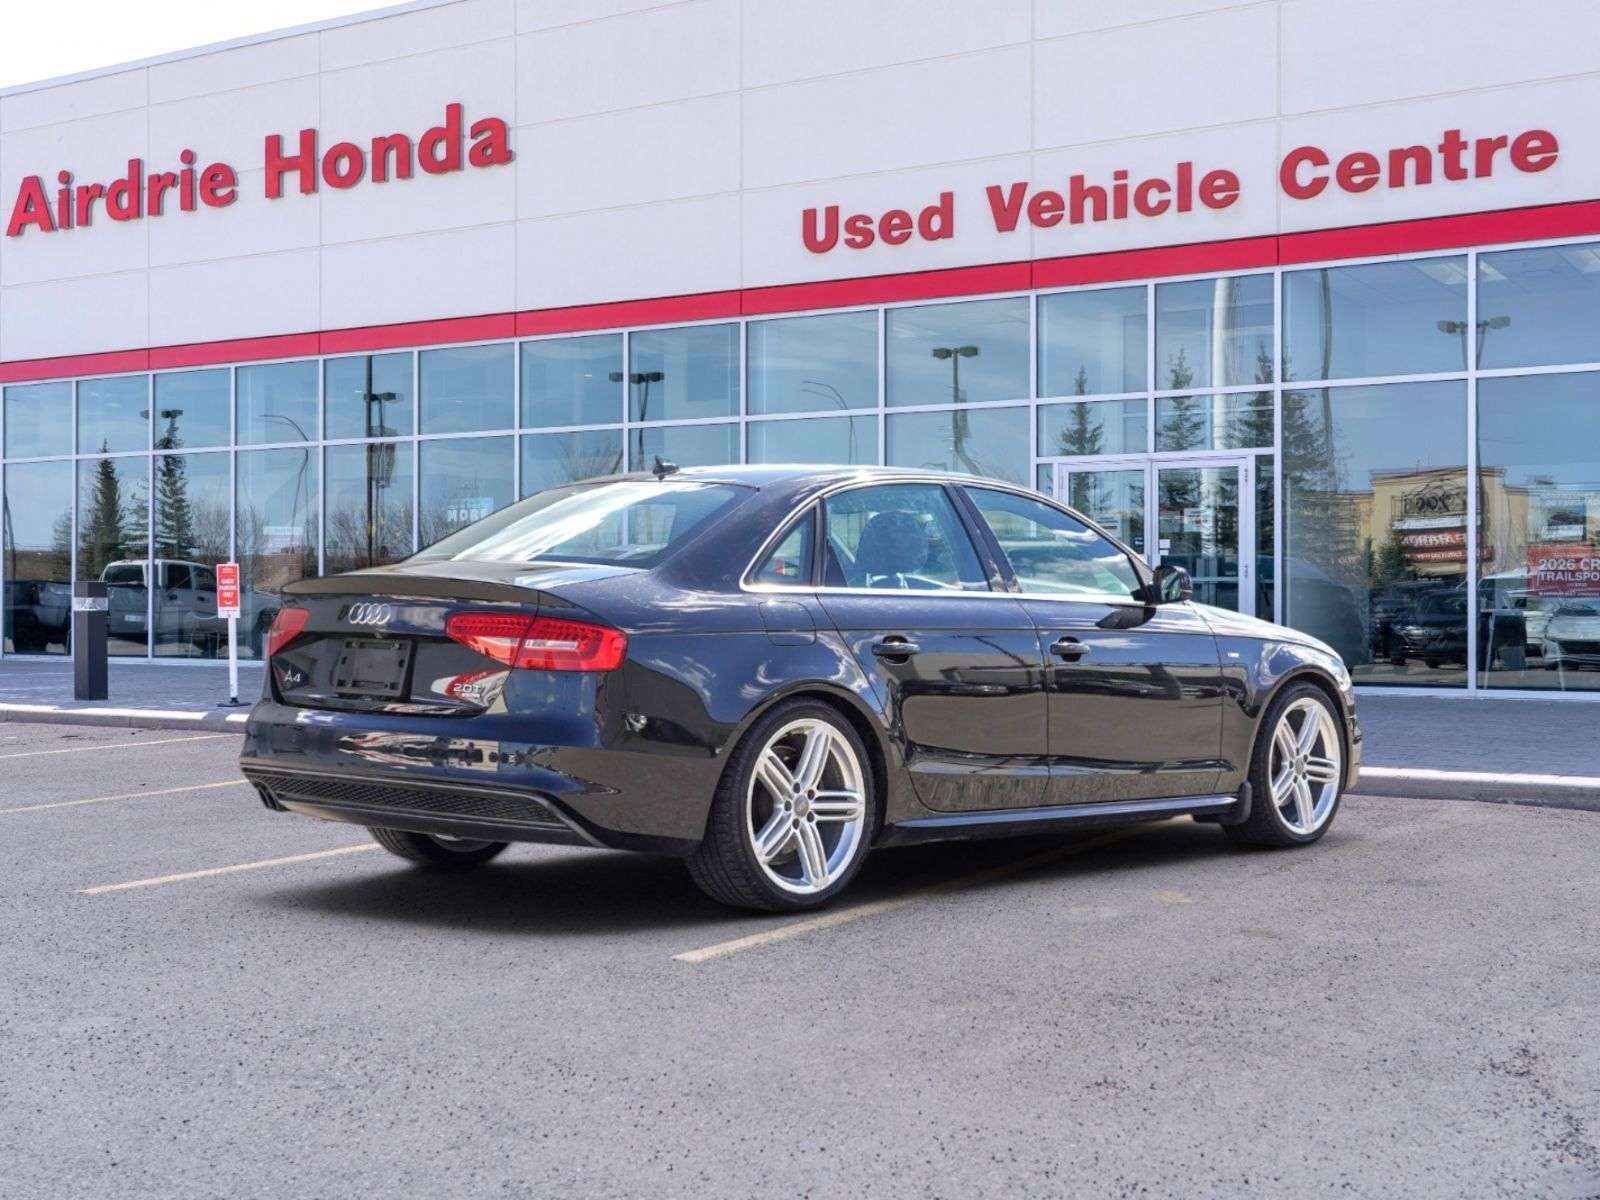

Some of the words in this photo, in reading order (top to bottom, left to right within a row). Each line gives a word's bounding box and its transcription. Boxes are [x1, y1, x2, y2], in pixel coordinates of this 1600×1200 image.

[7, 148, 237, 238] Airdrie
[264, 102, 514, 199] Honda
[802, 191, 954, 254] Used
[986, 161, 1240, 232] Vehicle
[1279, 128, 1560, 201] Centre
[1539, 558, 1576, 570] 2026
[284, 669, 301, 682] A4
